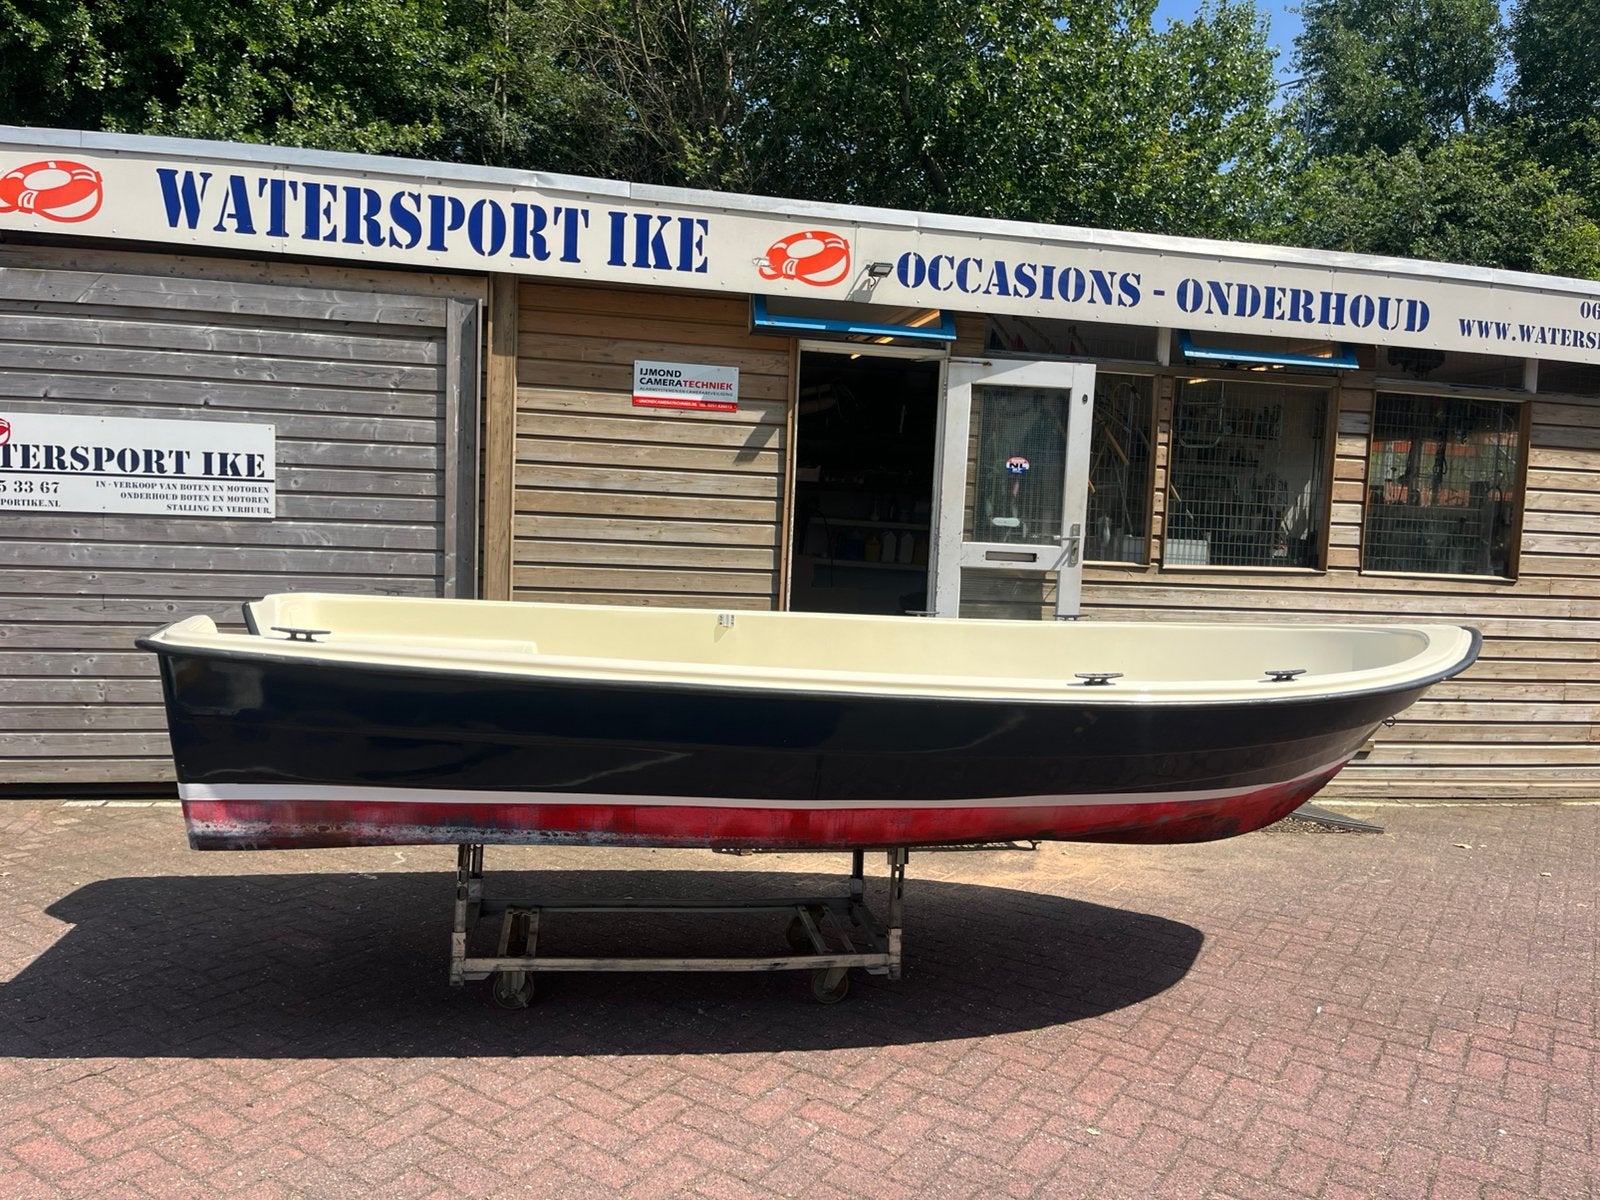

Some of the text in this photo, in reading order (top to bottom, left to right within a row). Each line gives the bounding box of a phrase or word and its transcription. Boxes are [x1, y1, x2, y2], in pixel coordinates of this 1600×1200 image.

[156, 168, 709, 273] WATERSPORT IKE
[897, 252, 1141, 307] OCCASIONS
[1176, 278, 1430, 332] ONDERHOUD
[640, 368, 682, 378] IJMOND
[639, 377, 733, 391] CAMERATECHNIEK
[0, 443, 265, 478] TERSPORT IKE
[13, 480, 34, 493] 33
[40, 481, 60, 494] 67
[96, 480, 106, 488] IN
[113, 481, 157, 490] VERKOOP
[160, 483, 177, 491] VAN
[180, 483, 210, 492] BOTEN
[226, 485, 269, 494] MOTOREN
[120, 492, 178, 501] ONDERHOUD
[180, 494, 210, 502] BOTEN
[226, 495, 269, 504] MOTOREN
[166, 503, 209, 512] STALLING
[212, 505, 224, 513] EN
